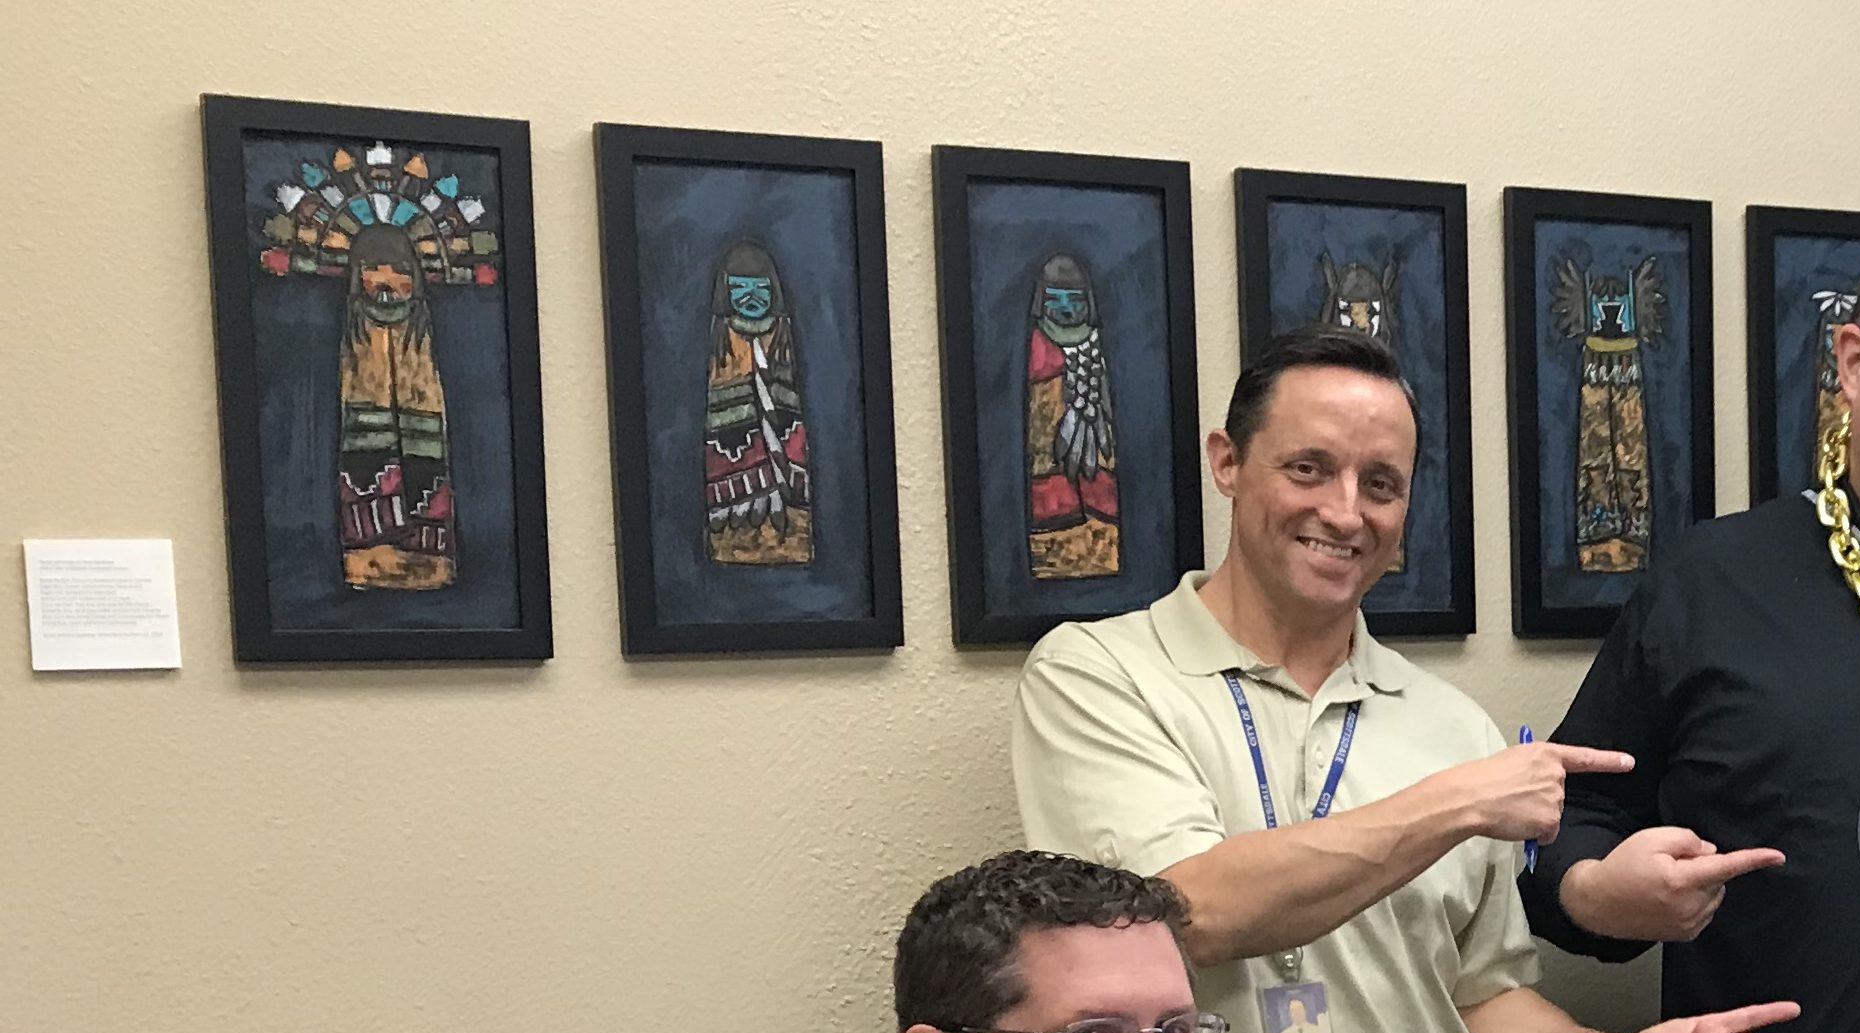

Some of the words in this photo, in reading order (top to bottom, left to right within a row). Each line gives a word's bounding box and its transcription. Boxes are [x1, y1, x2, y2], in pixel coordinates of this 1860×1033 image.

[1227, 675, 1247, 706] SCOTT
[1240, 708, 1252, 721] OF
[1245, 723, 1257, 747] CITY
[1335, 711, 1356, 764] SCOTTSDALE
[1260, 783, 1276, 827] TTSDALE
[1317, 792, 1332, 815] CITY
